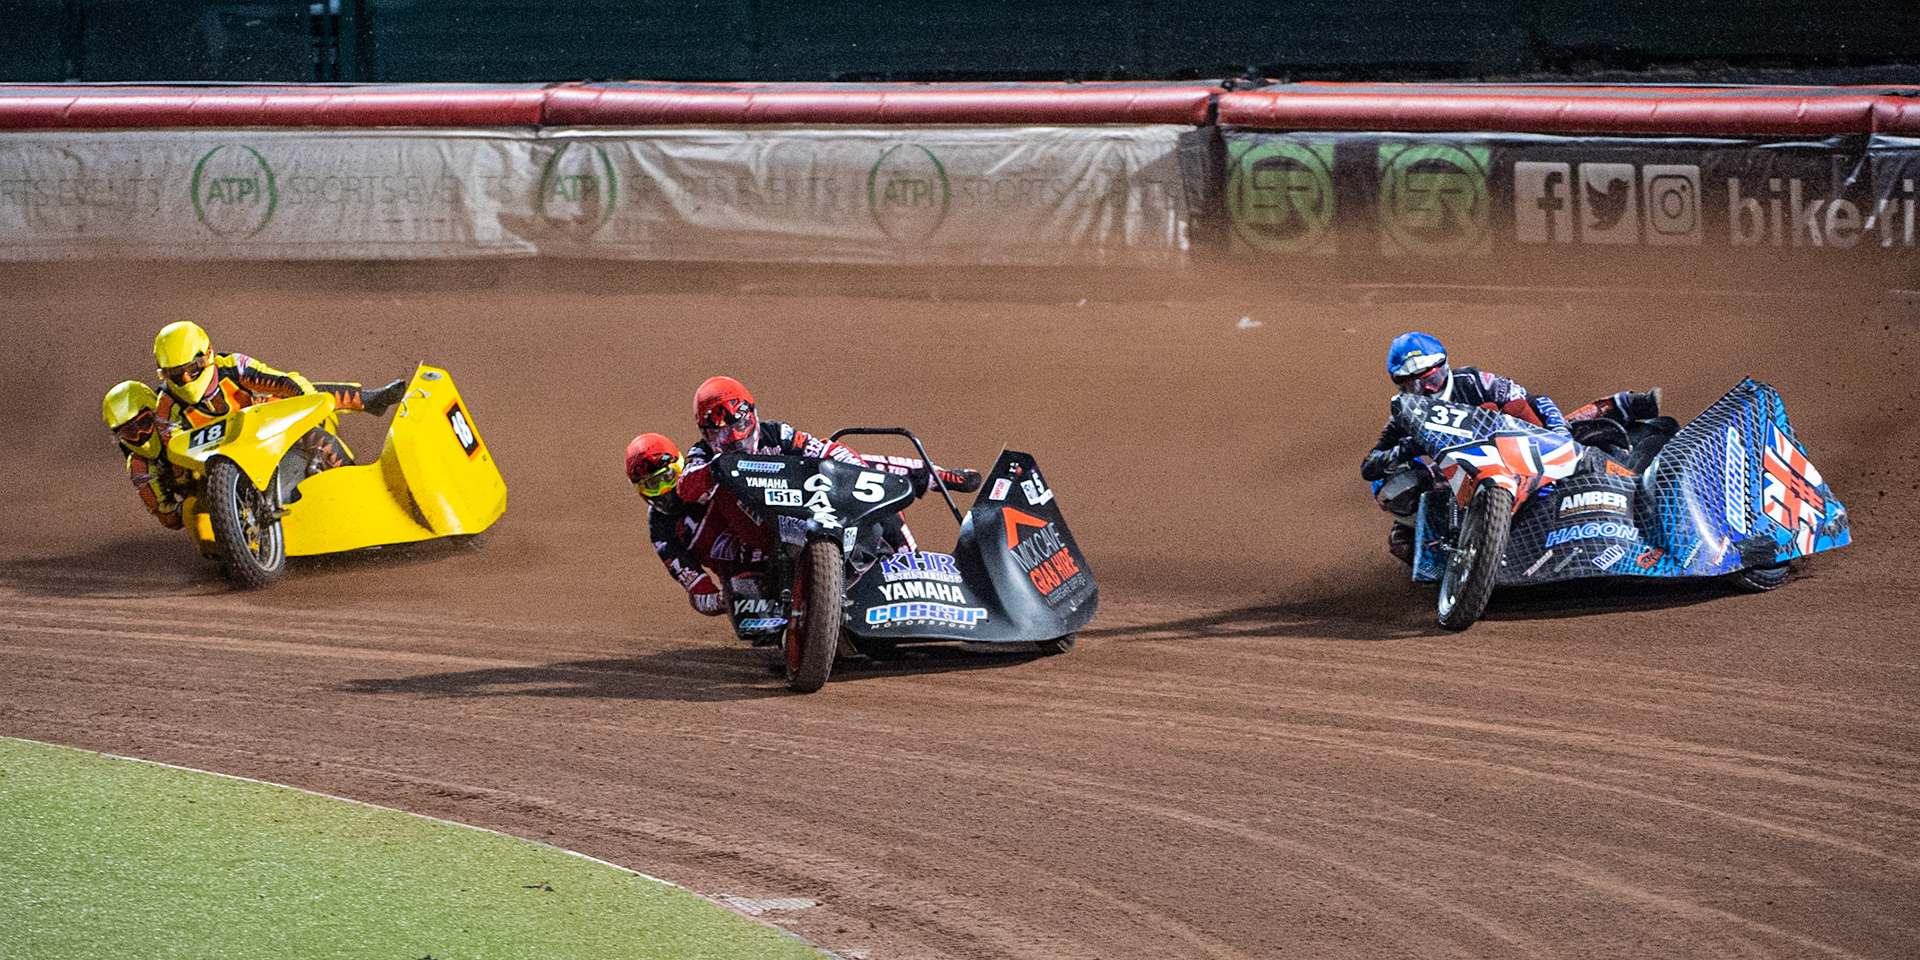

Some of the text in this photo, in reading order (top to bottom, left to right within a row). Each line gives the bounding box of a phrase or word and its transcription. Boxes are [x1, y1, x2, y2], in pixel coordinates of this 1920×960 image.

[206, 176, 261, 204] ATPI
[883, 176, 934, 208] ATPI
[1430, 405, 1468, 428] 37
[194, 424, 222, 445] 18
[451, 410, 474, 449] 18
[746, 477, 788, 490] YAMAHA
[852, 471, 885, 503] 5
[1560, 490, 1627, 511] AMBER
[1545, 522, 1639, 548] HAGON
[1010, 522, 1066, 573] NICK CAVE
[1594, 546, 1624, 569] Rally
[881, 551, 962, 575] KHR
[1030, 561, 1061, 595] GRAB
[1050, 547, 1079, 581] HIRE
[878, 581, 967, 604] YAMAHA
[871, 618, 976, 630] MOTORSPORT
